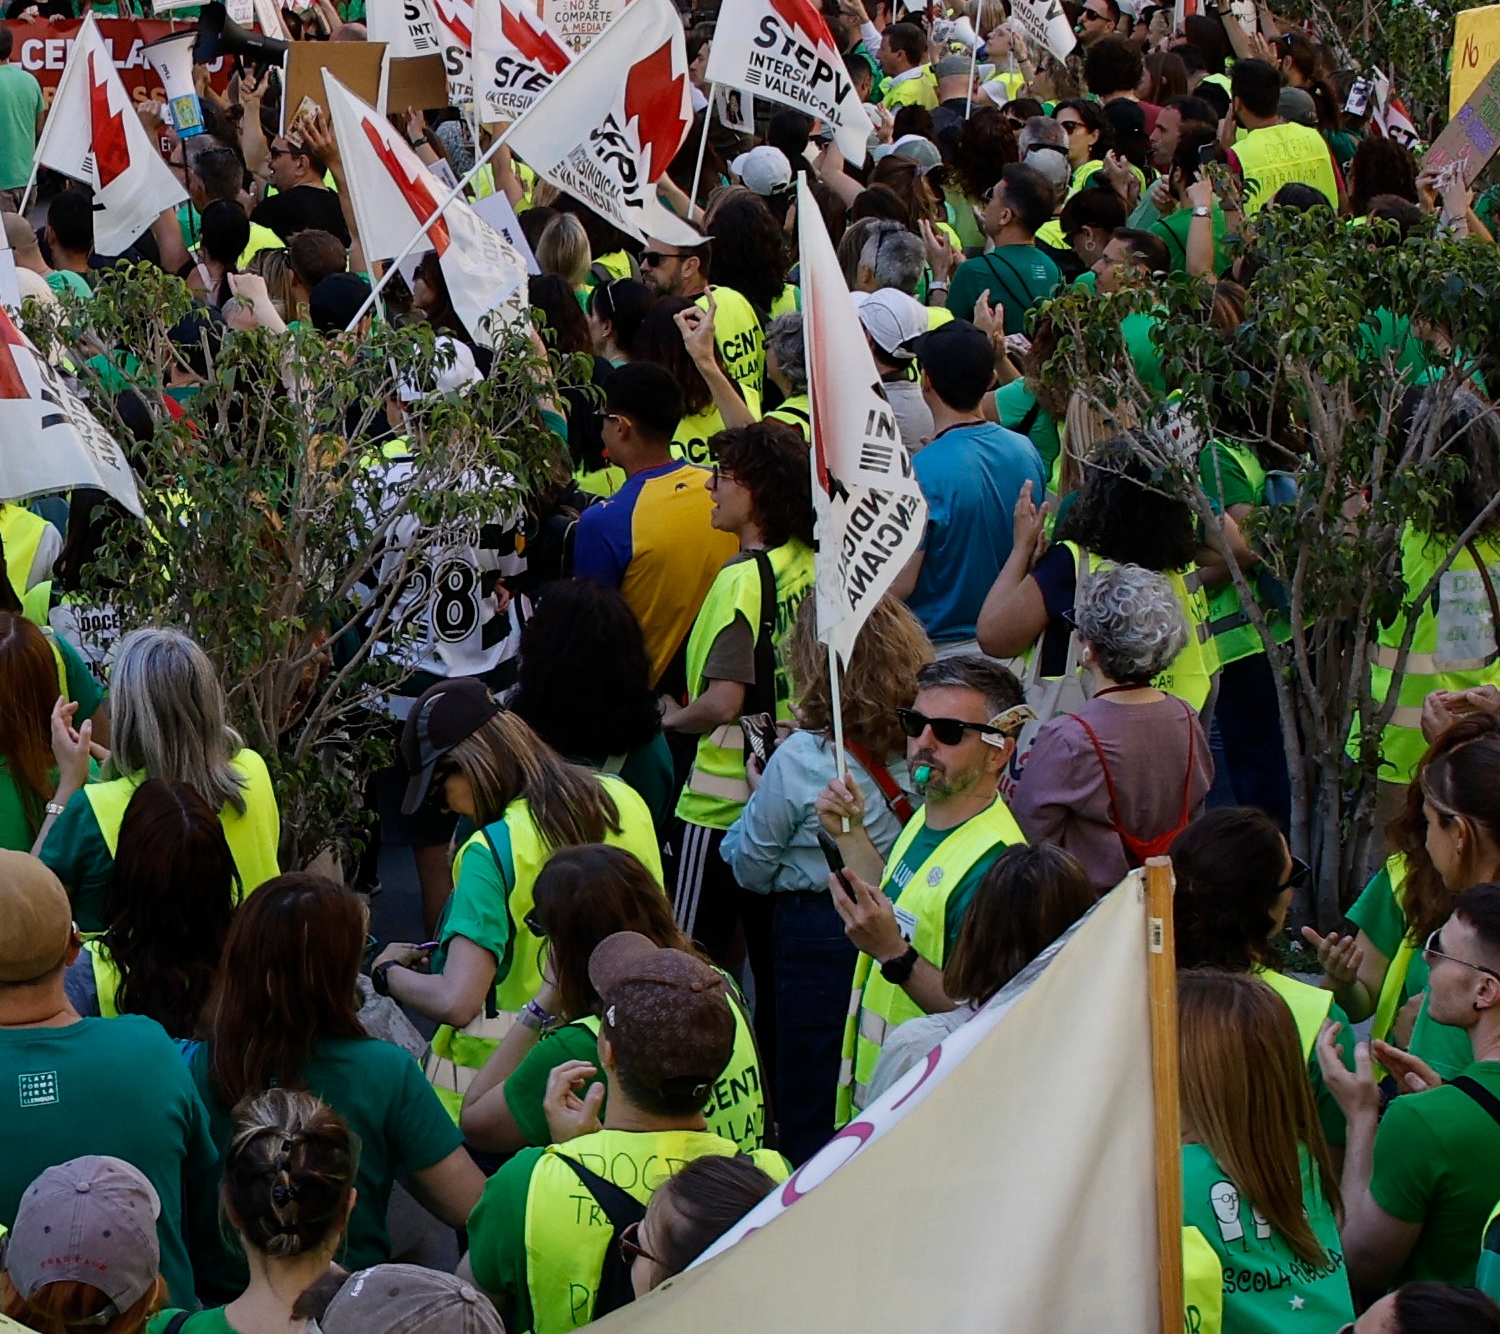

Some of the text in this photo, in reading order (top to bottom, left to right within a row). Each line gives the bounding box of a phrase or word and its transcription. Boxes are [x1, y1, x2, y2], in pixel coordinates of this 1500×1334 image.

[569, 0, 600, 10] NO SE
[555, 11, 612, 22] COMPARTE
[562, 24, 568, 32] A
[722, 326, 758, 363] CENT
